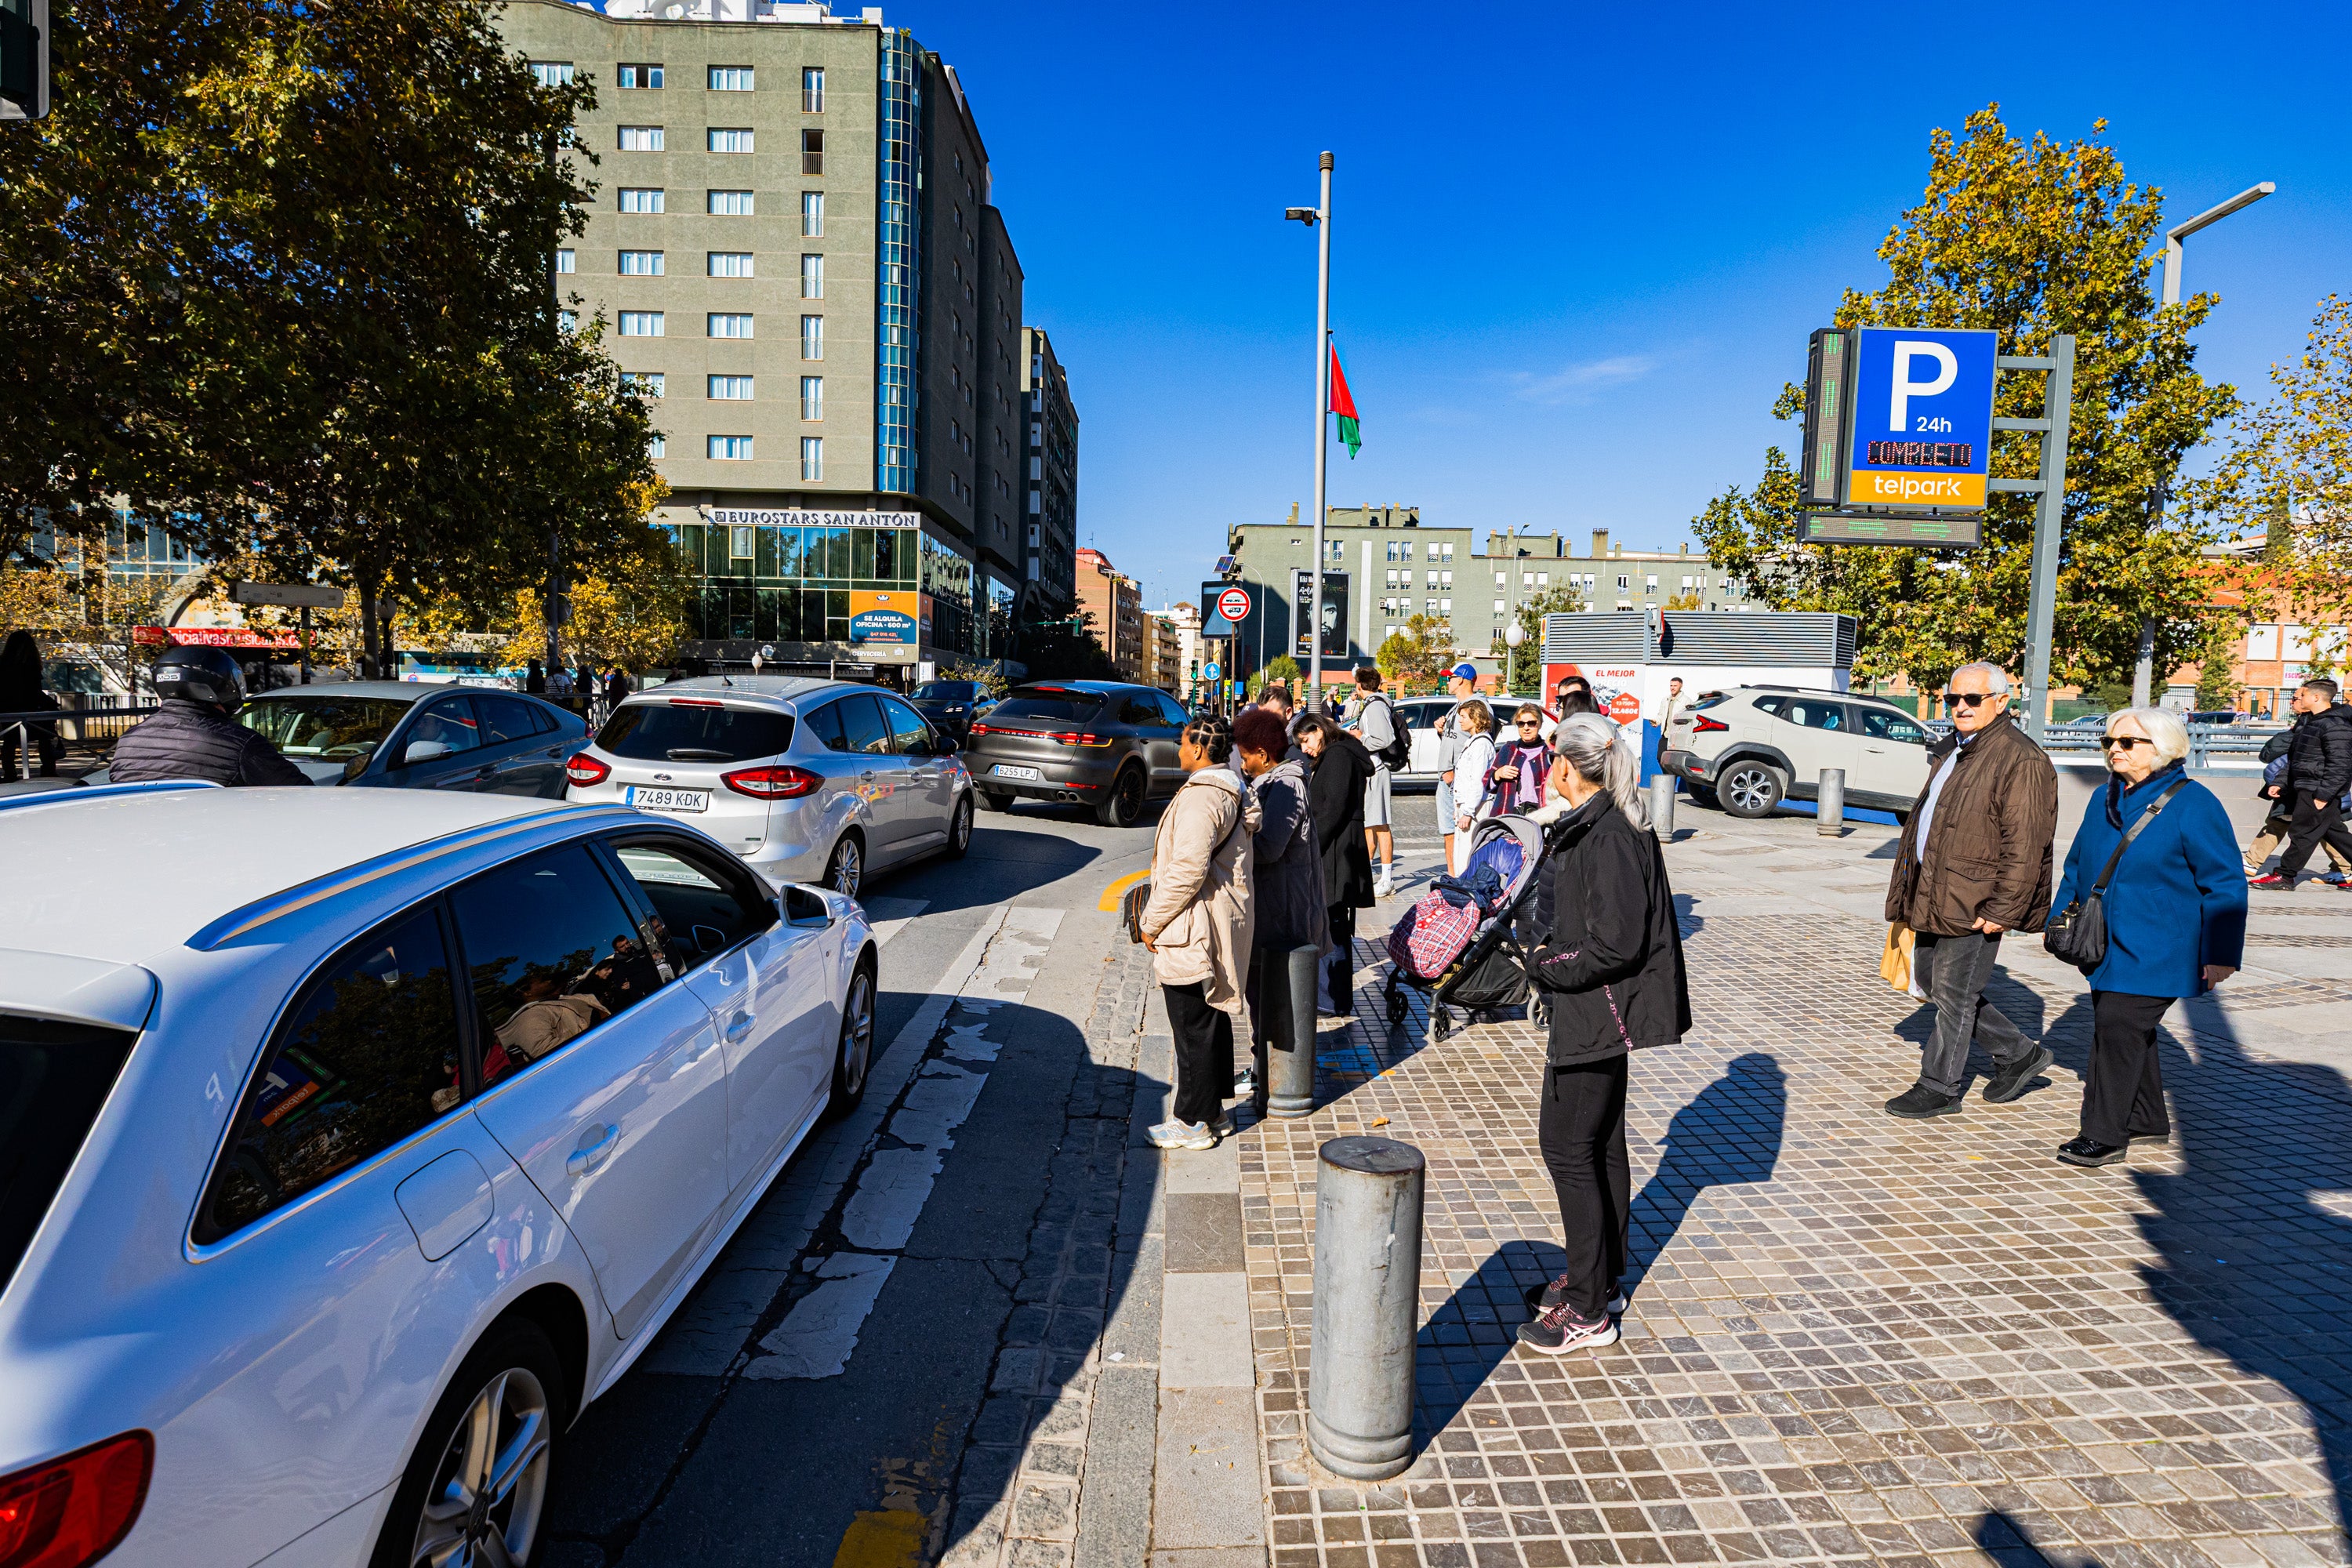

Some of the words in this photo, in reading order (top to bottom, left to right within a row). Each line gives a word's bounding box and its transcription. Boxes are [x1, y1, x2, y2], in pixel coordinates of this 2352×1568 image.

[1889, 340, 1958, 432] P
[1916, 416, 1951, 433] 24h
[1867, 441, 1972, 466] COMPLETO
[1875, 475, 1962, 499] telpark
[728, 511, 819, 525] EUROSTARS
[823, 513, 855, 525] SAN
[858, 513, 916, 526] ANTÓN
[999, 767, 1018, 776] 6255
[1020, 768, 1036, 779] LPJ
[638, 790, 672, 804] 7489
[676, 793, 702, 807] KDK
